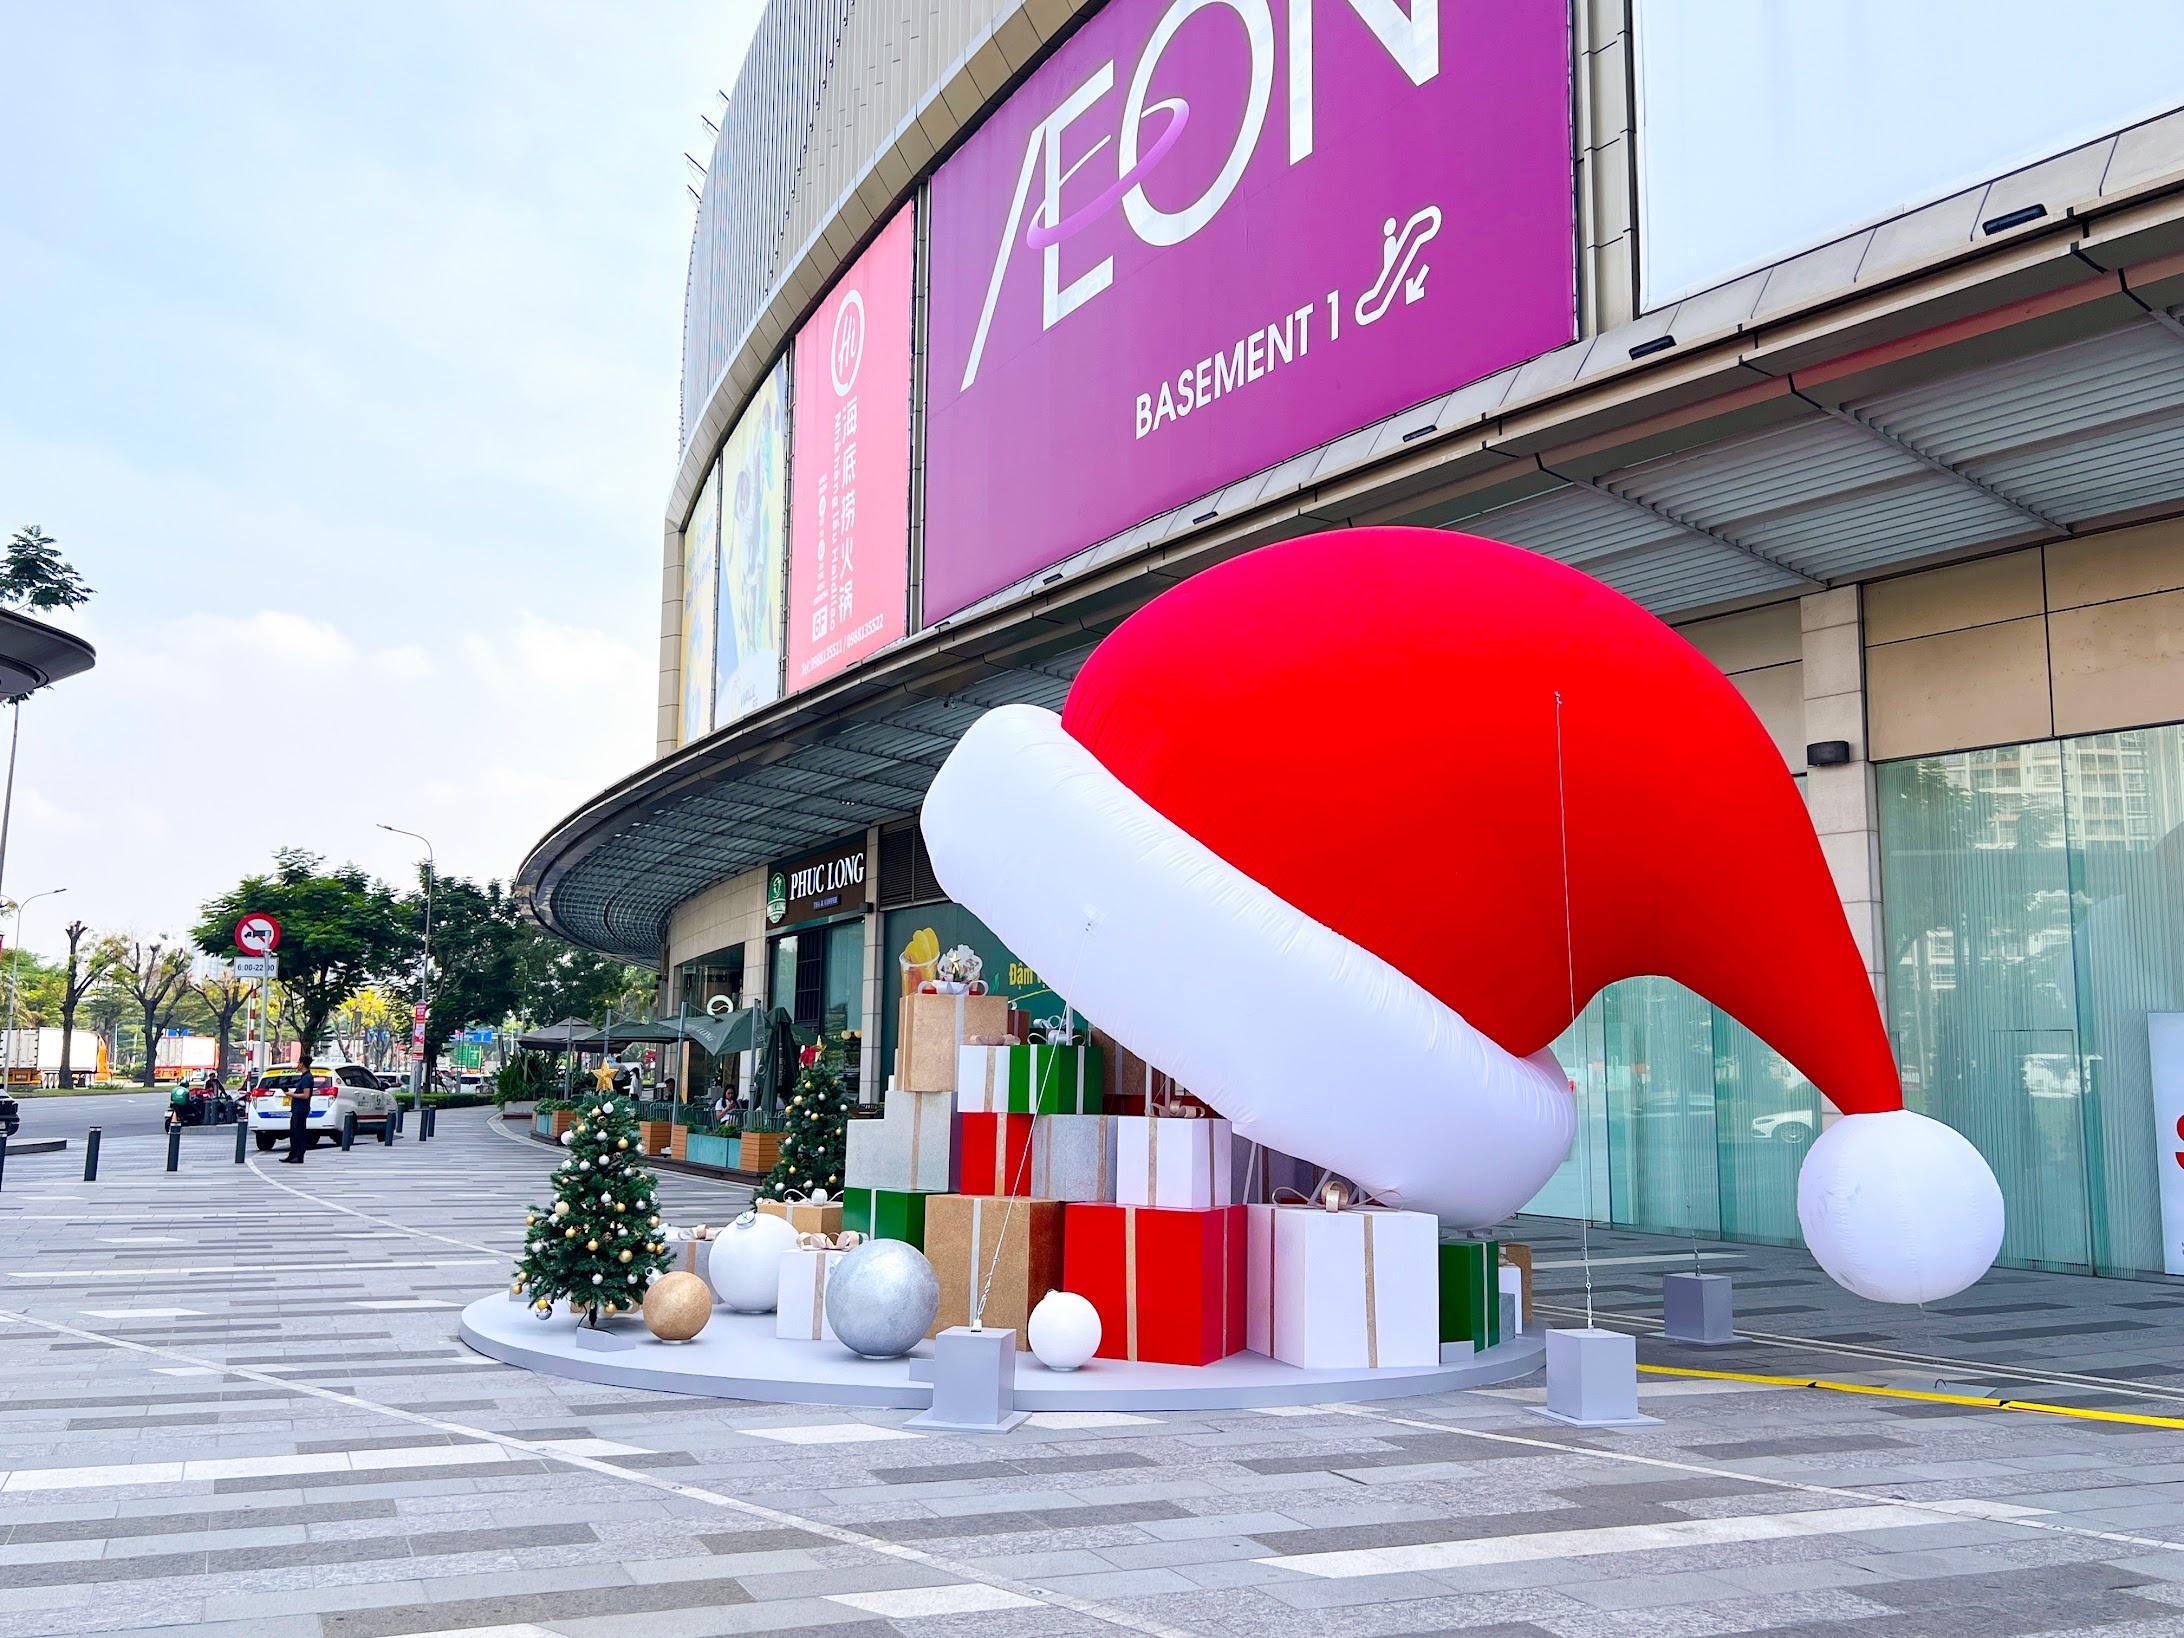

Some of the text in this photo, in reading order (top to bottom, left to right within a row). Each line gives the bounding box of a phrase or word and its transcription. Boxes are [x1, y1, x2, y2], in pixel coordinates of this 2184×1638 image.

[1136, 289, 1340, 440] BASEMENT 1
[840, 396, 857, 624] 海底捞火锅
[814, 609, 827, 638] 6F
[789, 852, 865, 900] PHUC LONG
[237, 963, 275, 972] 6:00-220
[1009, 962, 1034, 991] Đậm
